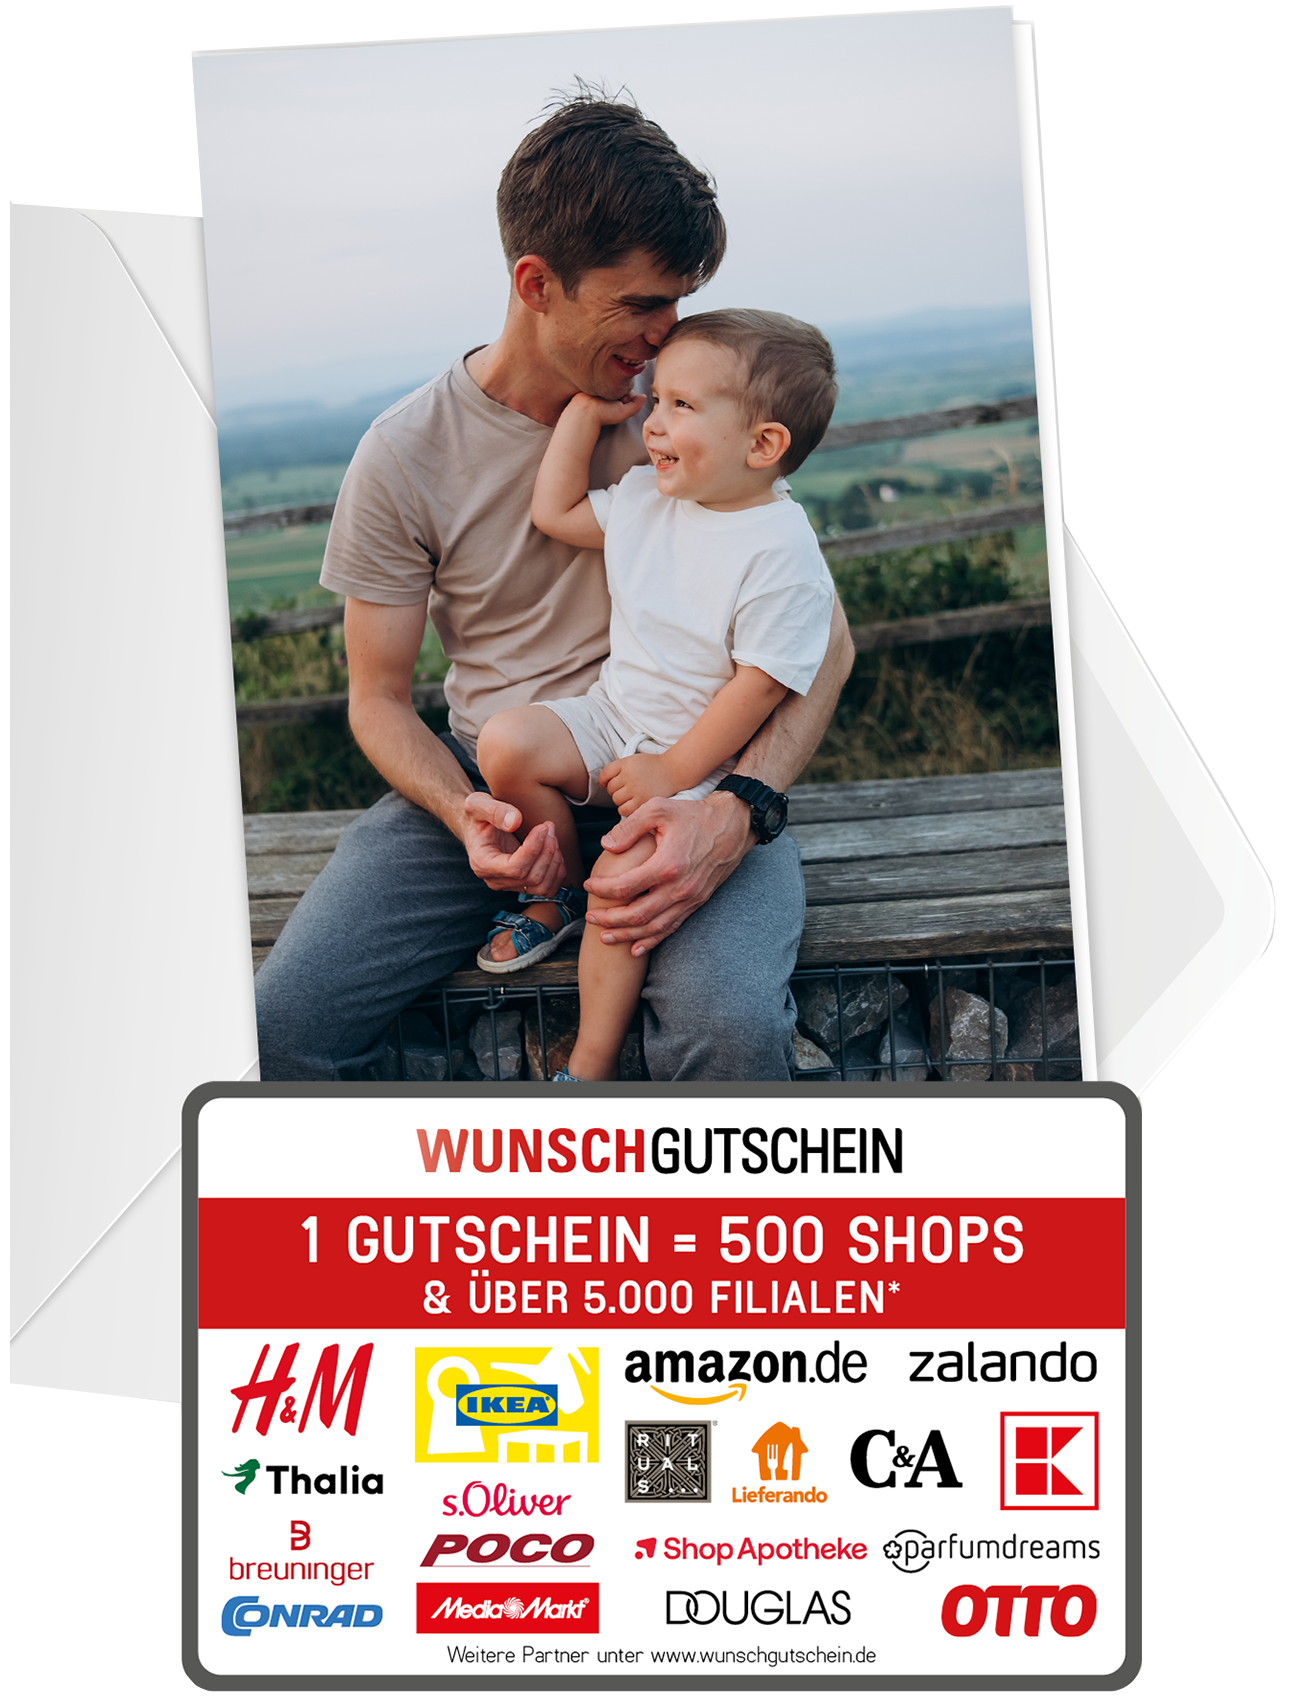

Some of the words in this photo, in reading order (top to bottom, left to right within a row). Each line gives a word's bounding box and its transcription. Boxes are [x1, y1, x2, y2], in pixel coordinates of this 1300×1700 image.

[416, 1127, 902, 1174] WUNSCHGUTSCHEIN
[301, 1216, 317, 1262] 1
[348, 1215, 648, 1263] GUTSCHEIN
[674, 1234, 696, 1252] =
[720, 1215, 823, 1263] 500
[849, 1215, 1023, 1263] SHOPS
[424, 1280, 451, 1314] &
[470, 1269, 567, 1314] ÜBER
[584, 1280, 692, 1314] 5.000
[625, 1340, 867, 1383] amazon.de
[909, 1341, 1097, 1382] zalando
[230, 1342, 374, 1436] H&M
[850, 1429, 963, 1489] C&A
[266, 1465, 383, 1495] Thalia
[442, 1481, 571, 1517] s.Oliver
[732, 1486, 828, 1503] Lieferando
[420, 1533, 595, 1567] POCO
[664, 1537, 733, 1566] Shop
[737, 1537, 867, 1566] Apotheke
[904, 1533, 1101, 1560] parfumdreams
[230, 1557, 374, 1586] breuninger
[221, 1596, 383, 1636] CONRAD
[666, 1590, 851, 1625] DOUGLAS
[941, 1584, 1097, 1637] OTTO
[447, 1646, 515, 1663] Weitere
[523, 1645, 589, 1663] Partner
[597, 1649, 644, 1663] unter
[651, 1646, 876, 1667] www.wunschgutschein.de
